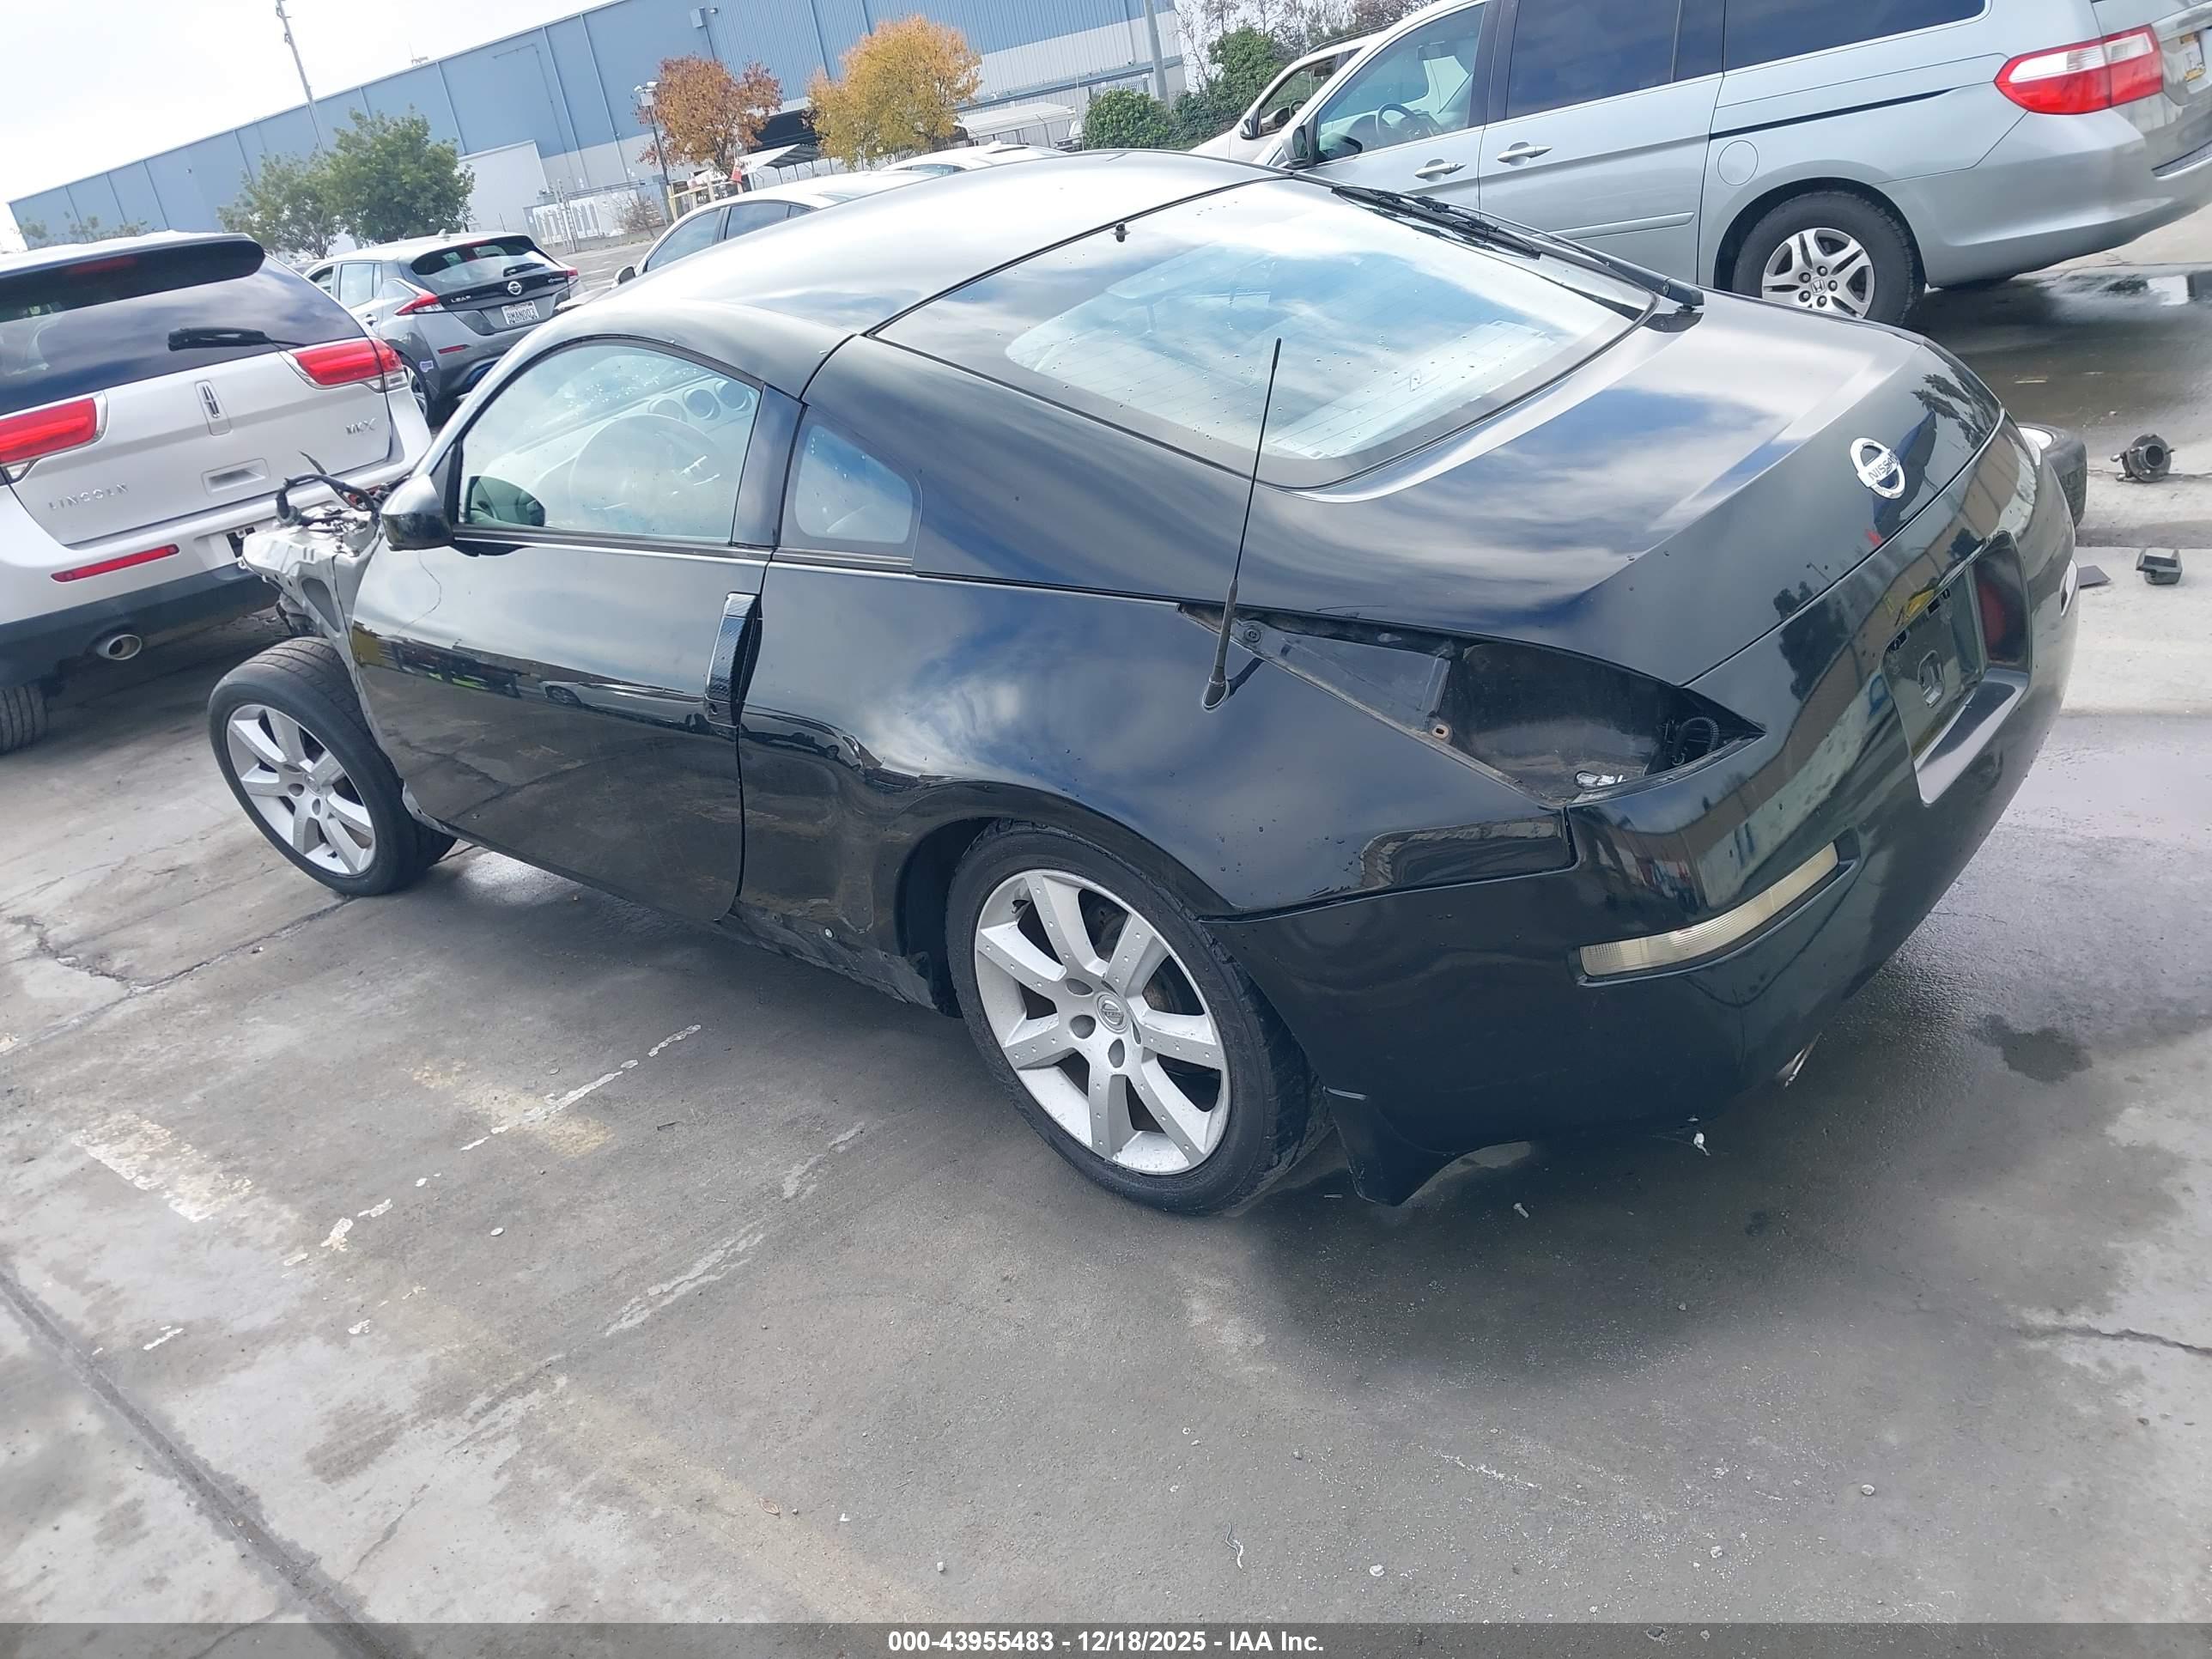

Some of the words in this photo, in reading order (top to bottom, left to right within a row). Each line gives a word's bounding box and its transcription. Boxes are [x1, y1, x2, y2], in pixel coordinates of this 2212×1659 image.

[450, 295, 471, 303] LEAF
[345, 417, 378, 434] MKX
[48, 482, 129, 510] LINCOLN
